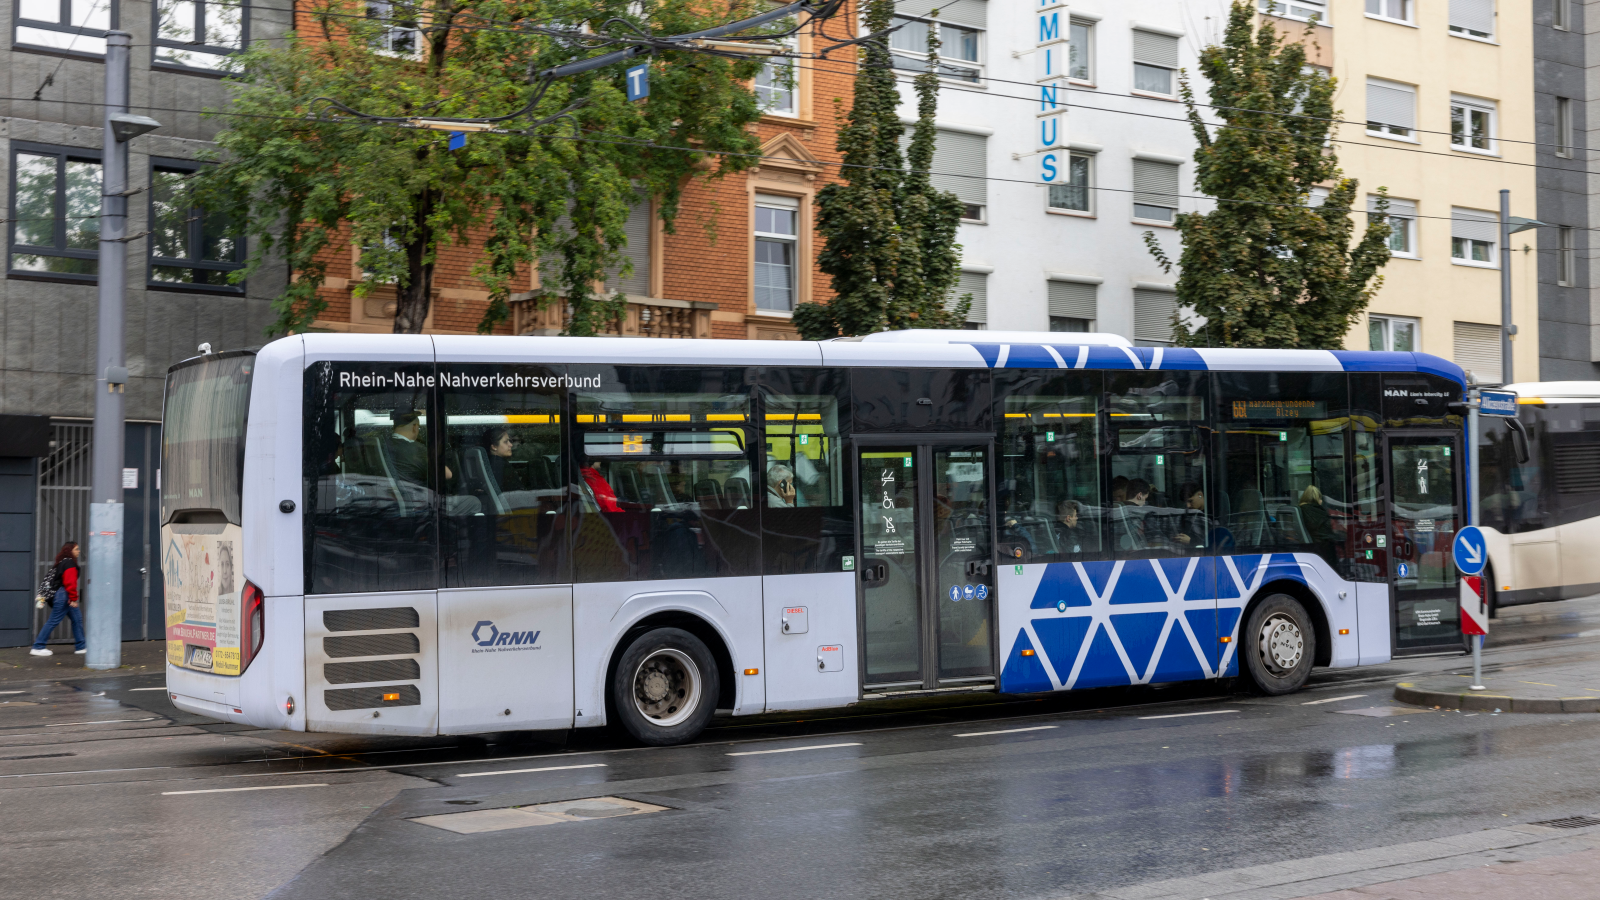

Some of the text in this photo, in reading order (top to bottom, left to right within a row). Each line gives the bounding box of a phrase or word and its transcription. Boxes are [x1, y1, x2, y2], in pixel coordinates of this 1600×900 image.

[628, 68, 645, 96] T
[1040, 0, 1059, 182] MINUS
[339, 372, 601, 388] Rhein-Nahe Nahverkehrsverbund
[1384, 389, 1408, 397] MAN
[1276, 408, 1299, 417] Alzey
[189, 488, 203, 498] MAN
[495, 631, 541, 646] RNN
